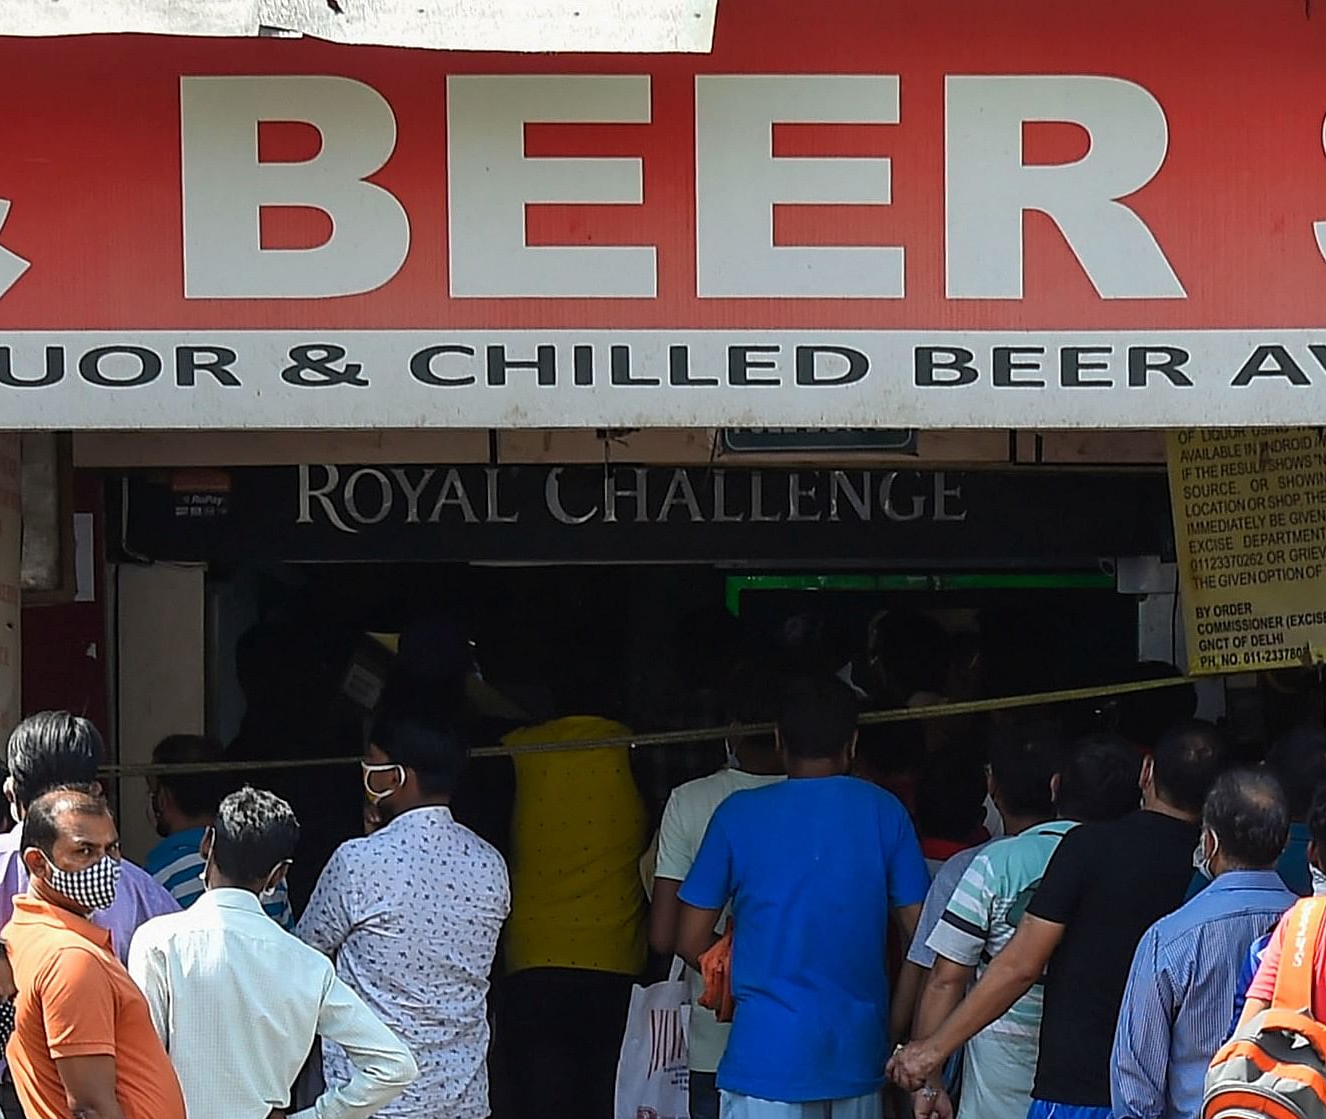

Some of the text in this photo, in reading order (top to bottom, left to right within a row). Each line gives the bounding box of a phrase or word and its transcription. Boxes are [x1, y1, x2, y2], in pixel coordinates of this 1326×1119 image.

[179, 74, 1188, 300] BEER
[281, 343, 370, 388] &
[409, 343, 871, 388] CHILLED
[913, 344, 1193, 388] BEER
[1178, 430, 1195, 445] OF
[1180, 443, 1243, 463] AVAILABLE
[1244, 442, 1257, 456] IN
[1181, 466, 1193, 481] IF
[1195, 464, 1218, 480] THE
[1269, 454, 1312, 472] SHOWS
[1250, 478, 1269, 493] OR
[296, 464, 968, 533] ROYAL CHALLENGE
[1185, 497, 1245, 517] LOCATION
[1247, 495, 1266, 511] OR
[1303, 490, 1326, 505] THE
[1187, 515, 1266, 536] IMMEDIATELY
[1269, 512, 1286, 527] BE
[1289, 509, 1325, 526] GIVEN
[1189, 536, 1234, 554] EXCISE
[1243, 527, 1325, 548] DEPARTMENT
[1190, 552, 1263, 571] 01123370262
[1266, 550, 1285, 566] OR
[1192, 575, 1217, 590] THE
[1218, 570, 1256, 588] GIVEN
[1258, 567, 1304, 584] OPTION
[1306, 564, 1322, 579] OF
[1196, 602, 1252, 619] BY ORDER
[1197, 616, 1284, 635] COMMISSIONER
[1199, 632, 1284, 652] GNCT OF DELHI
[1243, 646, 1308, 664] 011-233780
